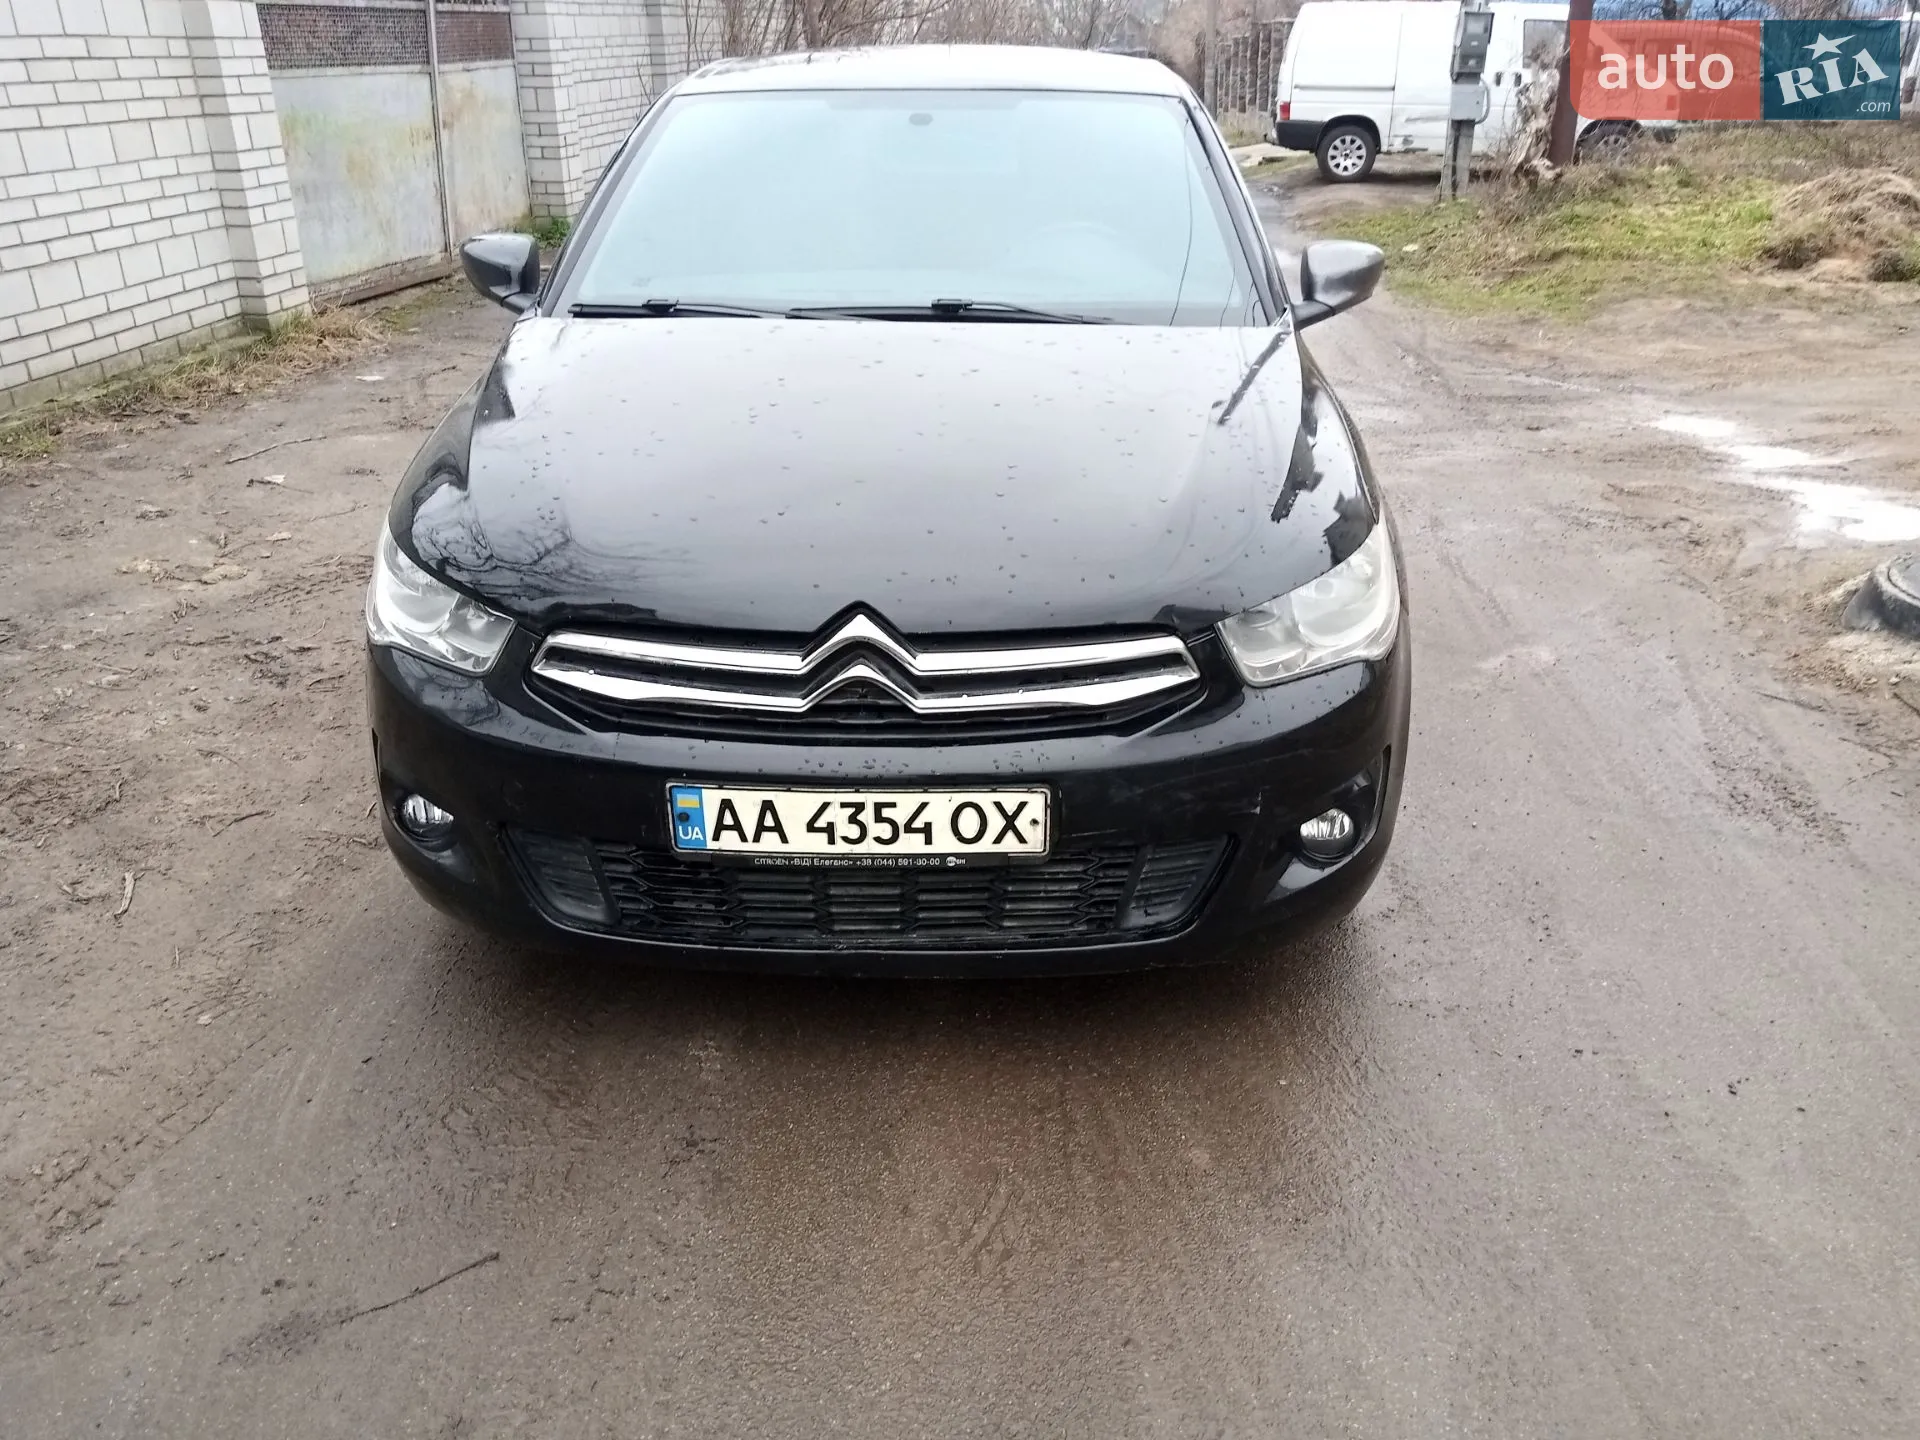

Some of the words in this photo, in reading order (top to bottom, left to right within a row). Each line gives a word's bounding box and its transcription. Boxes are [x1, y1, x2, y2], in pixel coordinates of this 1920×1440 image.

[711, 799, 789, 844] AA
[806, 801, 933, 845] 4354
[950, 801, 1029, 844] OX
[679, 826, 704, 841] UA
[856, 858, 872, 866] +38
[874, 857, 896, 867] (044)
